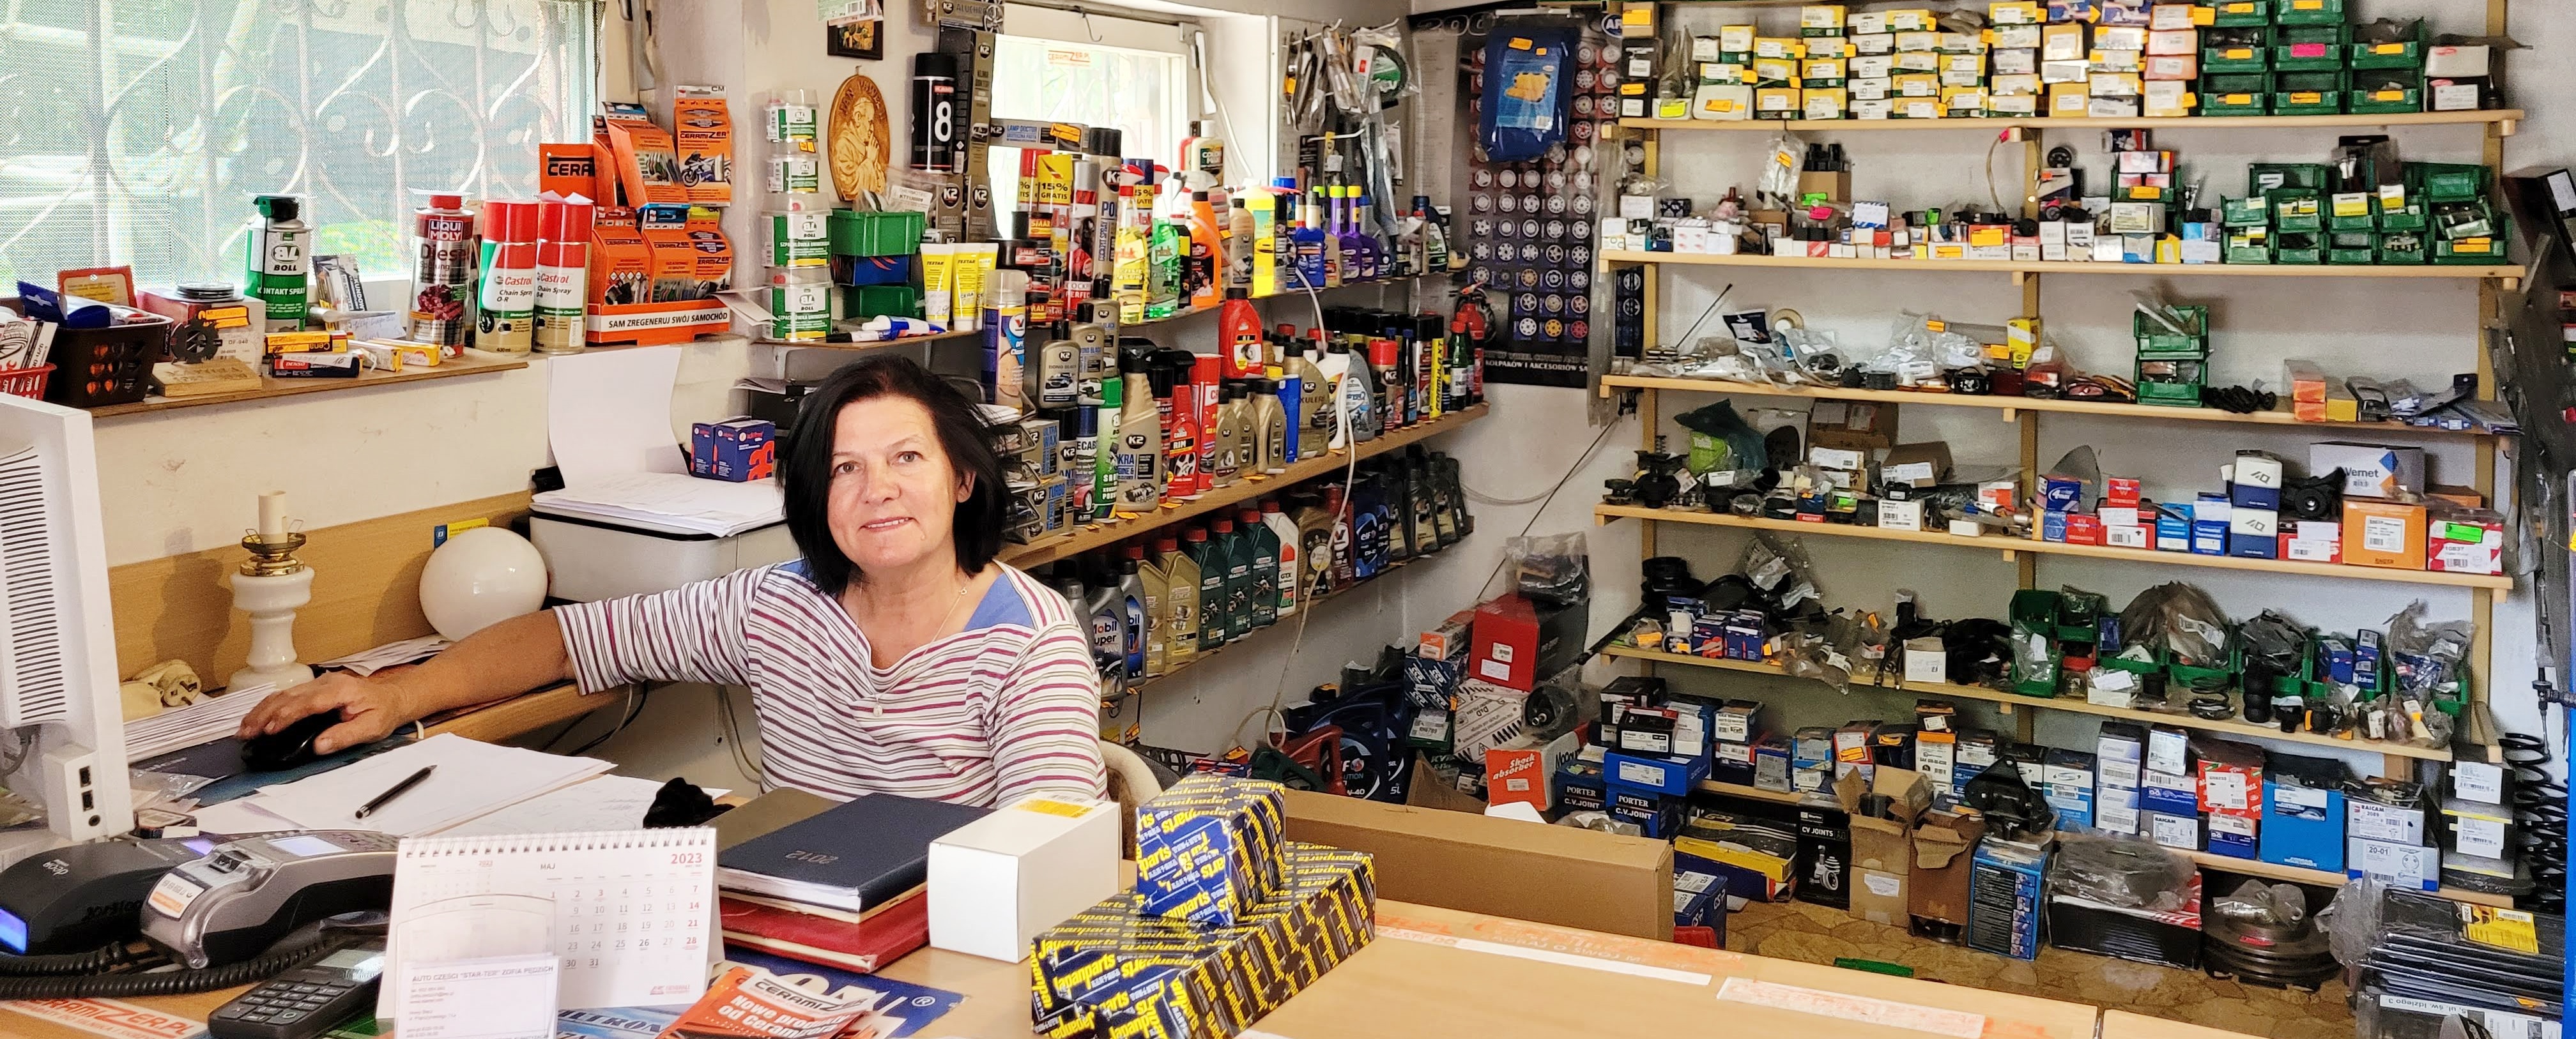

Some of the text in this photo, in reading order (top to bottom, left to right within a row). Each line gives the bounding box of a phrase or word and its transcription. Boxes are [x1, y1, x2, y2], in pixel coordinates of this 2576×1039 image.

[935, 101, 952, 142] 8
[943, 188, 958, 199] K2
[974, 190, 988, 201] K2
[431, 221, 462, 231] LIQUI
[429, 231, 462, 241] MOLY
[697, 257, 732, 265] ERAMIZER
[505, 277, 532, 285] Castrol
[540, 274, 569, 284] Castrol
[553, 287, 572, 296] Spray
[609, 312, 728, 328] SAM ZREGENERUJ SWÓJ SAMOCHÓD
[1485, 360, 1524, 368] KOŁPAKÓW
[1529, 362, 1576, 372] AKCESORIÓW
[1128, 436, 1145, 445] K2
[1173, 441, 1186, 450] RIM
[1063, 448, 1076, 457] K2
[2345, 467, 2379, 478] Vernet
[1034, 490, 1045, 501] K2
[1094, 635, 1116, 646] uper
[1510, 753, 1535, 768] Shock
[1492, 760, 1534, 780] absorber
[1567, 785, 1597, 797] PORTER
[1618, 795, 1649, 807] PORTER
[1811, 827, 1834, 837] JOINTS
[2368, 846, 2389, 856] 20-01
[671, 853, 703, 865] 2023
[785, 849, 839, 865] 2012
[568, 942, 578, 950] 23
[663, 937, 673, 946] 27
[565, 958, 599, 967] 30 31
[717, 1005, 742, 1020] od
[730, 995, 778, 1019] Nowe
